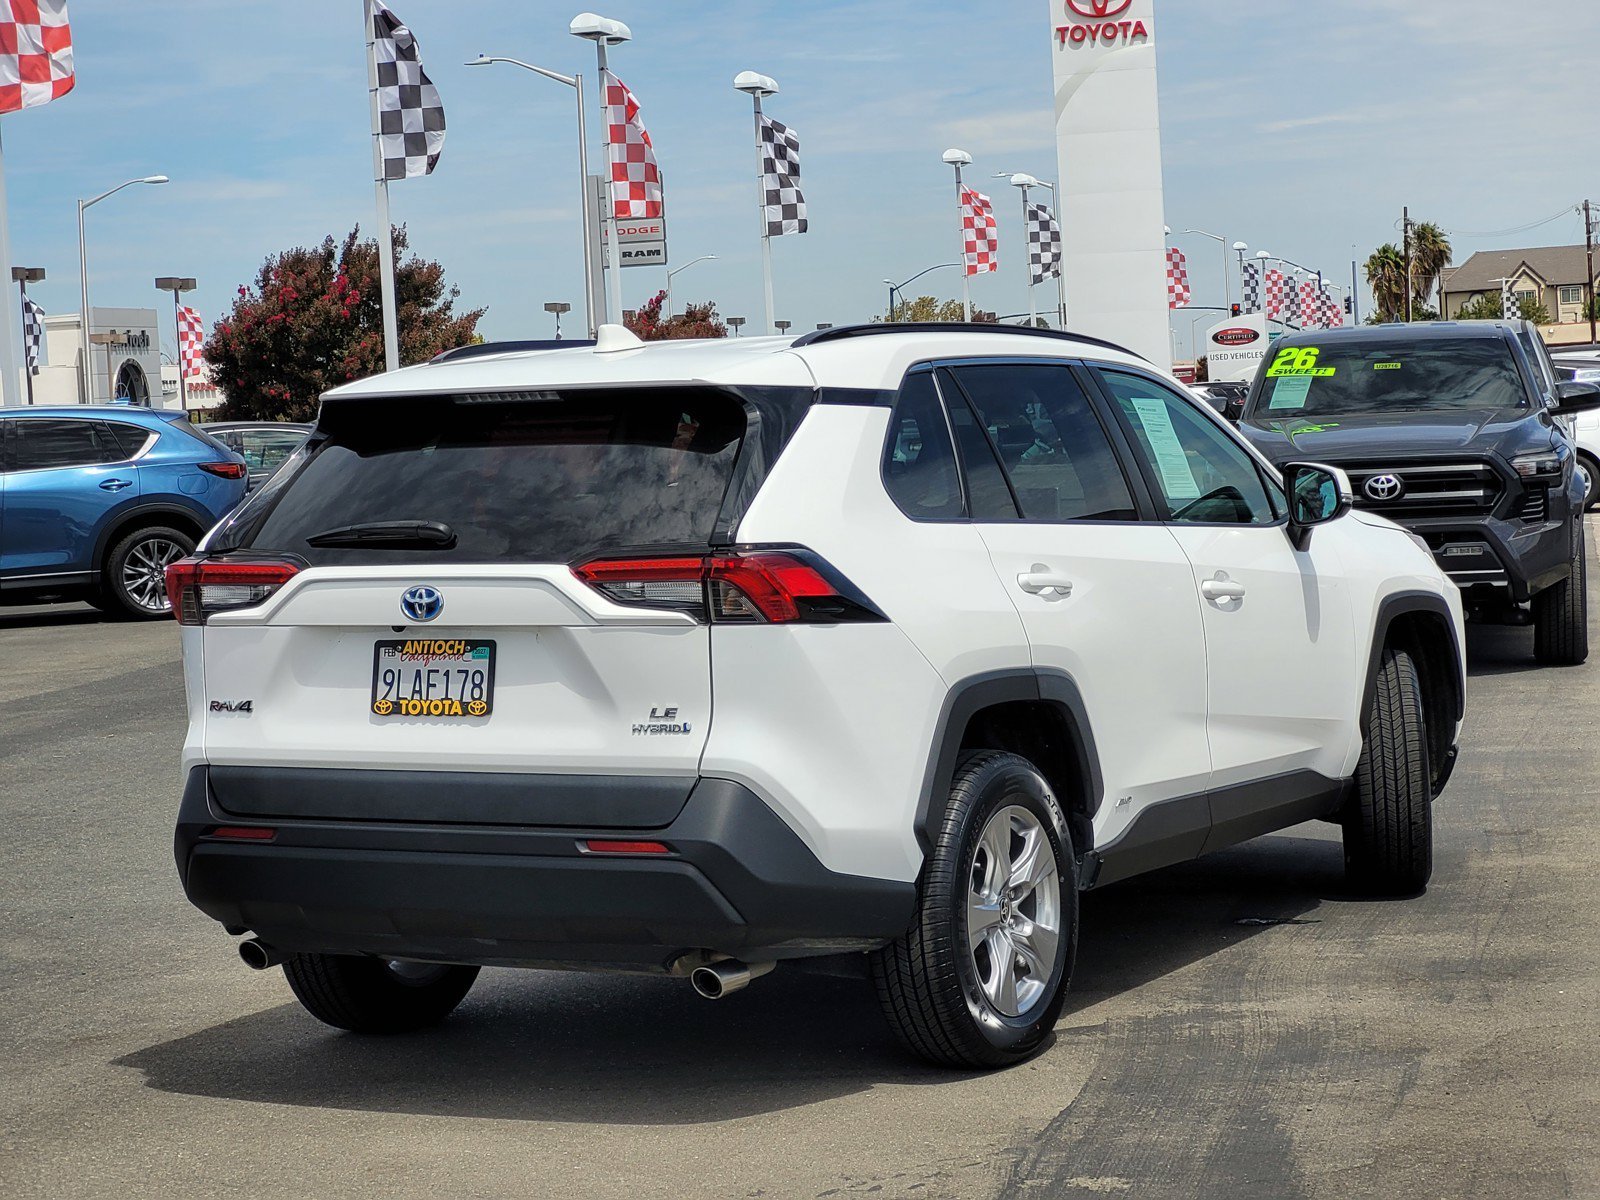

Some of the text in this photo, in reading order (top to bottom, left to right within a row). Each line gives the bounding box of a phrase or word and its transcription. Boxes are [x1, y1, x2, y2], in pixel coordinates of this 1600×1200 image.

[1056, 21, 1147, 43] TOYOTA
[622, 249, 661, 258] RAM
[1210, 351, 1264, 361] USED VEHICLES
[1272, 347, 1320, 369] 26
[383, 648, 396, 657] FEB
[402, 640, 466, 654] ANTIOCH
[382, 668, 484, 701] 9LAF178
[210, 700, 252, 713] RAV4
[400, 699, 463, 715] TOYOTA
[650, 708, 678, 718] LE
[632, 724, 681, 733] HYBRID
